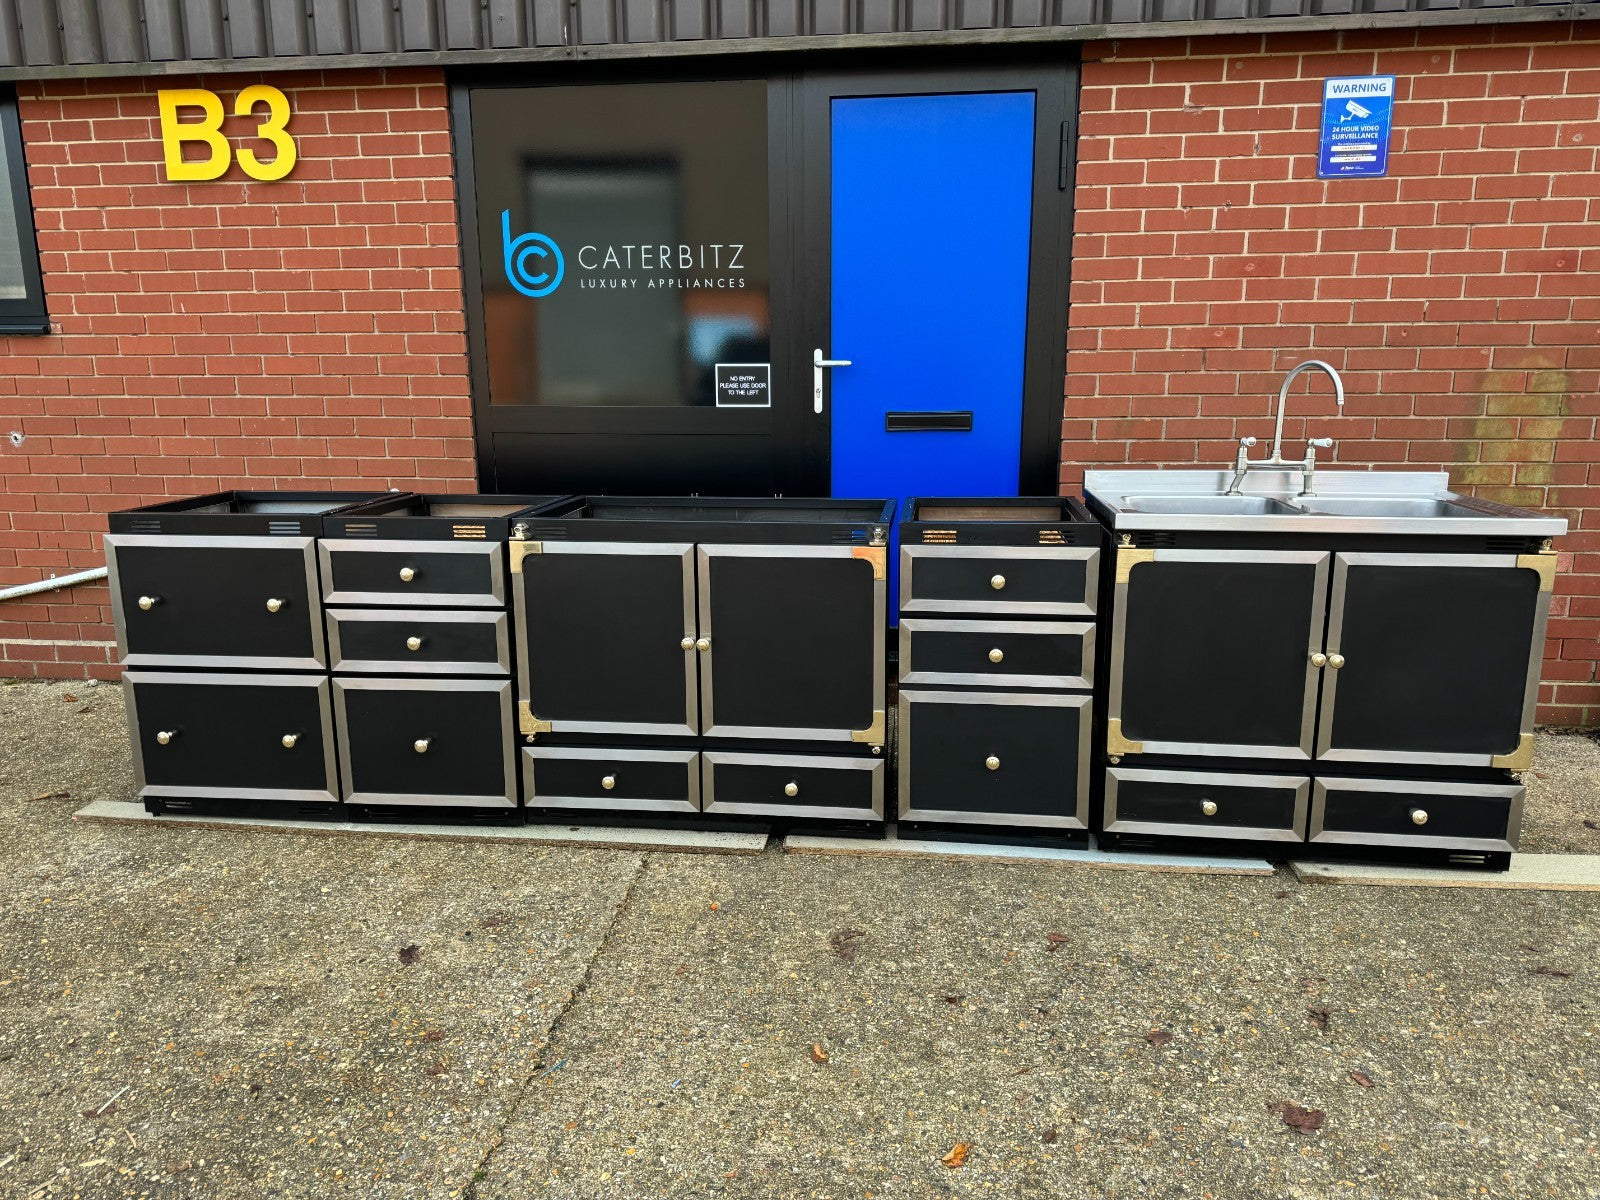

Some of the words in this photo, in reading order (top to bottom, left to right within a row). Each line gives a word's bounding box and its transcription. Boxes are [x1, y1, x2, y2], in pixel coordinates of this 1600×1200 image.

[1332, 82, 1387, 94] WARNING
[157, 84, 297, 181] B3
[1331, 132, 1379, 140] SURVEILLANCE
[578, 244, 745, 270] CATERBITZ
[580, 278, 638, 289] LUXURY
[647, 278, 746, 289] APPLIANCES
